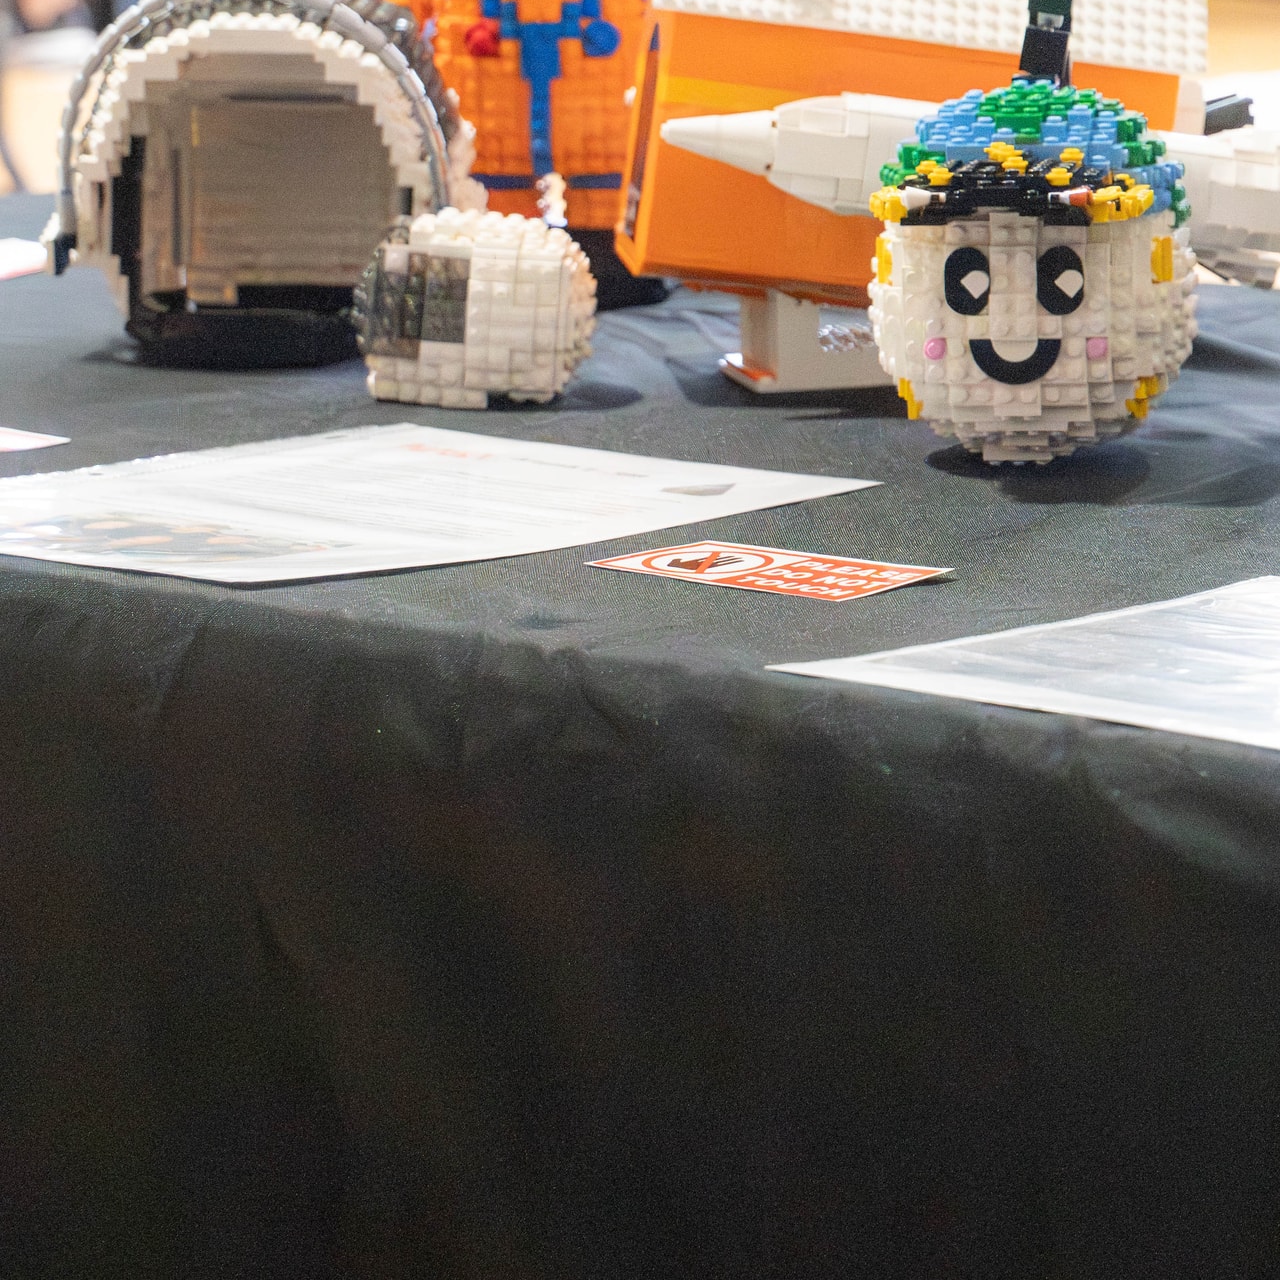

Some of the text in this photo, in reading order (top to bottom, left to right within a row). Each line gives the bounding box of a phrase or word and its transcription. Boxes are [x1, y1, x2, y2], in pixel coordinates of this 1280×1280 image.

[759, 568, 888, 590] DO NOT
[797, 560, 923, 581] PLEASE
[736, 576, 856, 597] TOUCH
